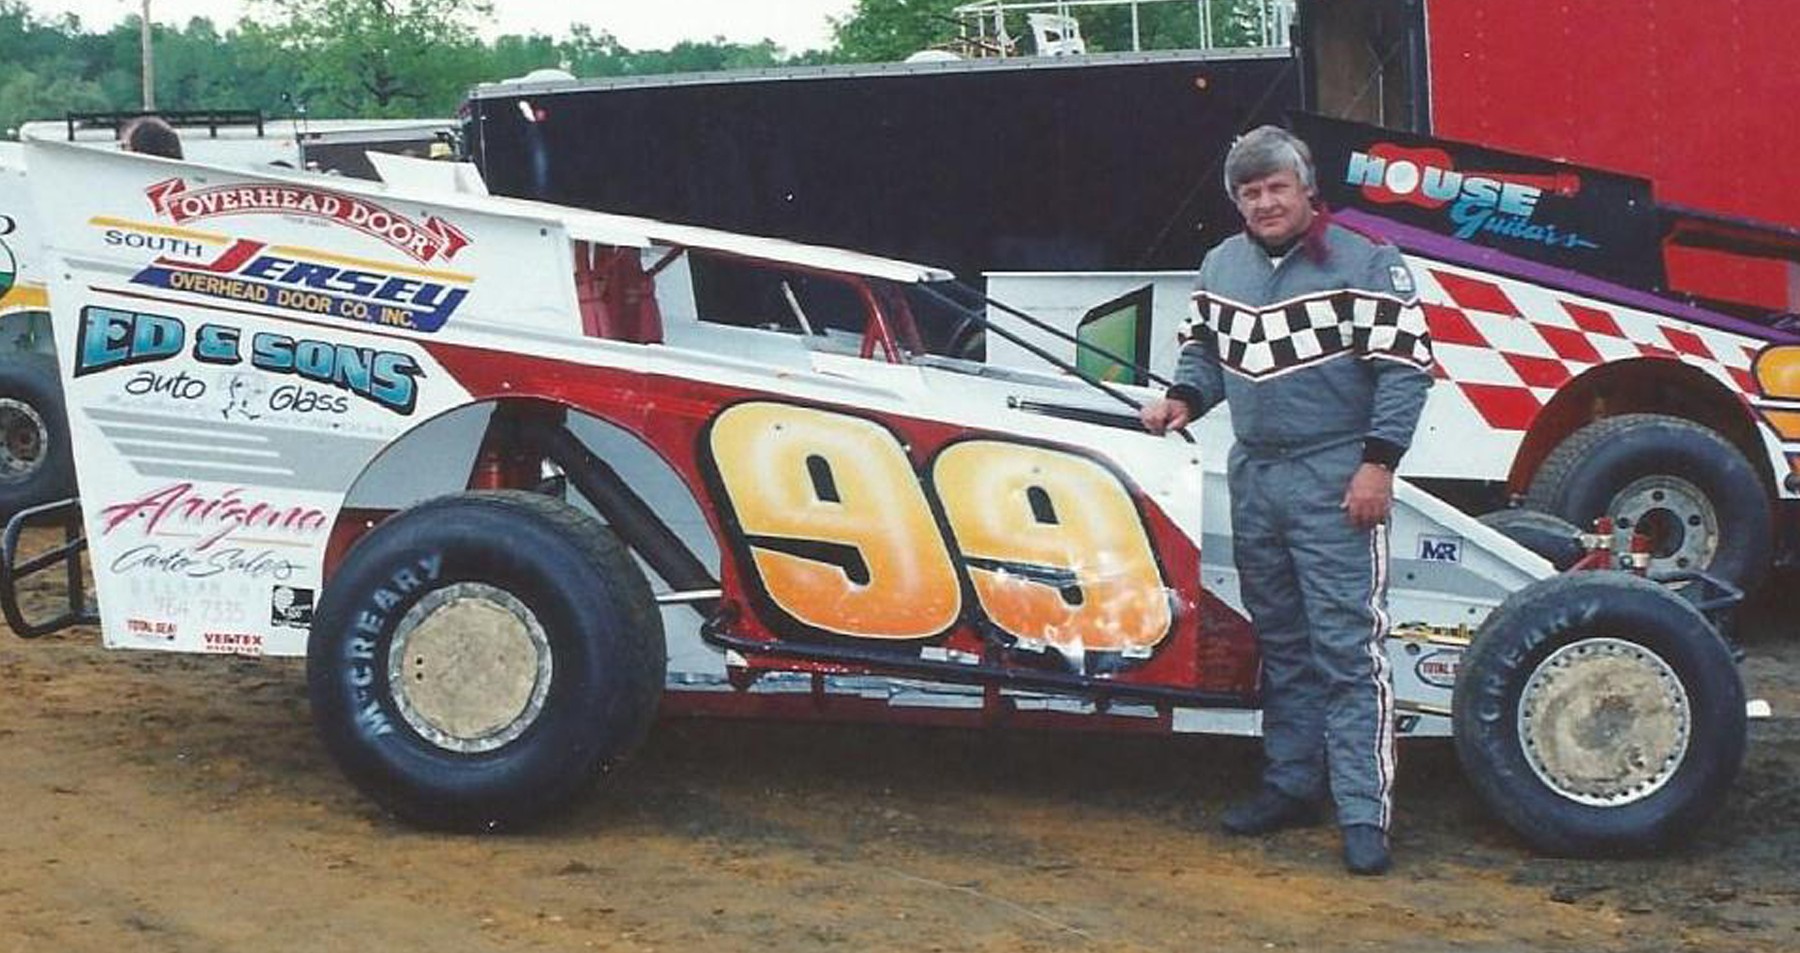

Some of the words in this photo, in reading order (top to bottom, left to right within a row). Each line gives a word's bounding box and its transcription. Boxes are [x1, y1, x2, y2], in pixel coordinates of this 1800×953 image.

[1347, 151, 1542, 217] HOUSE
[104, 230, 202, 257] SOUTH
[1451, 199, 1600, 248] Guitars
[152, 239, 470, 332] JERSEY
[170, 271, 269, 301] OVERHEAD
[276, 289, 332, 313] DOOR
[340, 302, 373, 320] CO.
[380, 307, 418, 328] INC.
[74, 305, 186, 378] ED
[193, 322, 243, 365] &
[251, 332, 427, 416] SONS
[125, 371, 206, 399] auto
[268, 385, 349, 414] Glass
[102, 483, 327, 550] Arizona
[706, 399, 1176, 654] 99
[204, 633, 263, 646] VERTEX
